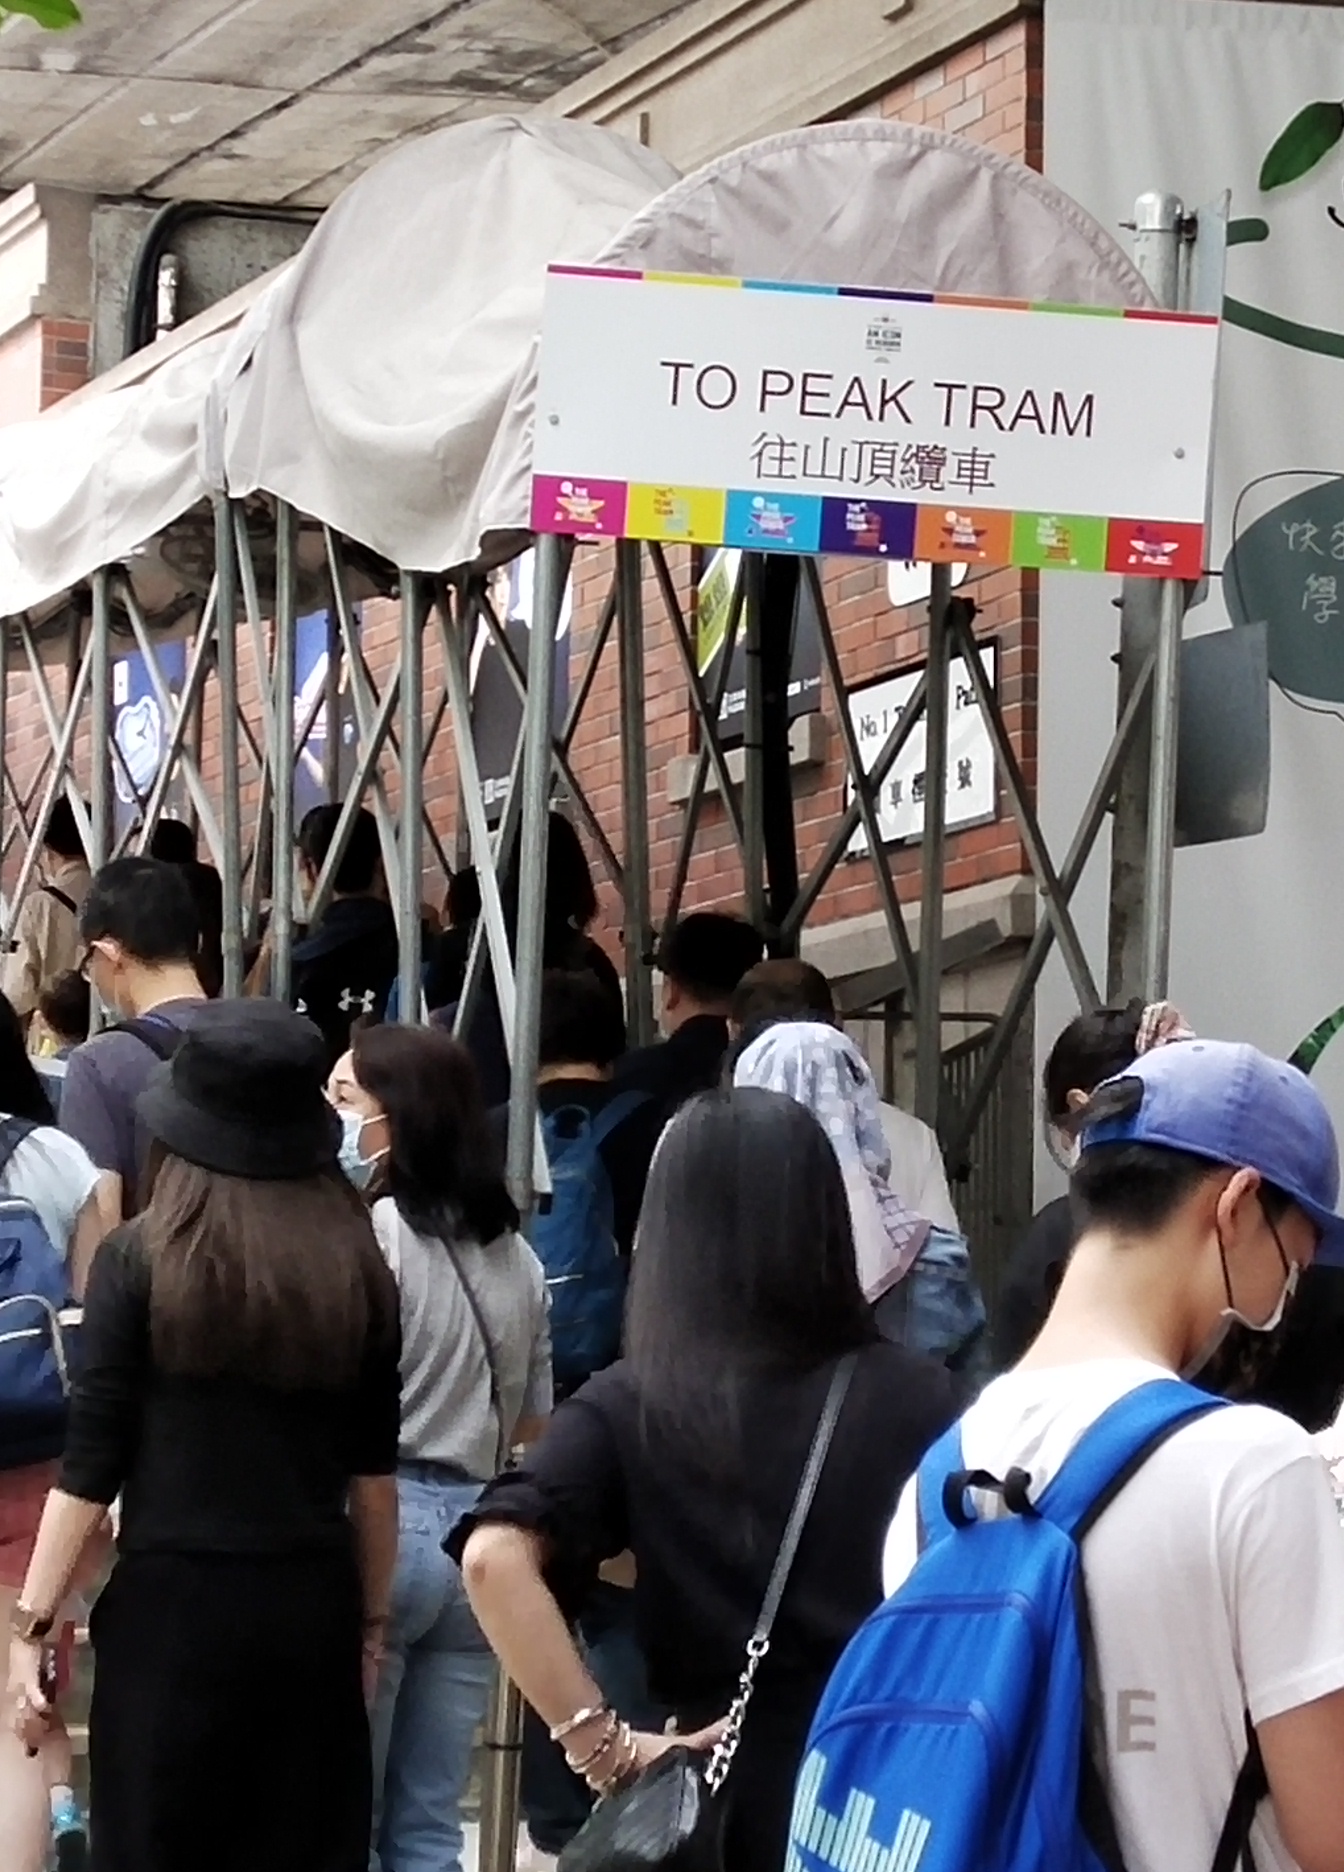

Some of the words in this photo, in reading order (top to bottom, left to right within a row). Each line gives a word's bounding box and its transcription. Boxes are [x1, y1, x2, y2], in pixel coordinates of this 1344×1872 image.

[660, 361, 736, 409] TO
[759, 369, 916, 424] PEAK
[934, 382, 1094, 437] TRAM
[749, 431, 997, 494] 往山頂纜車
